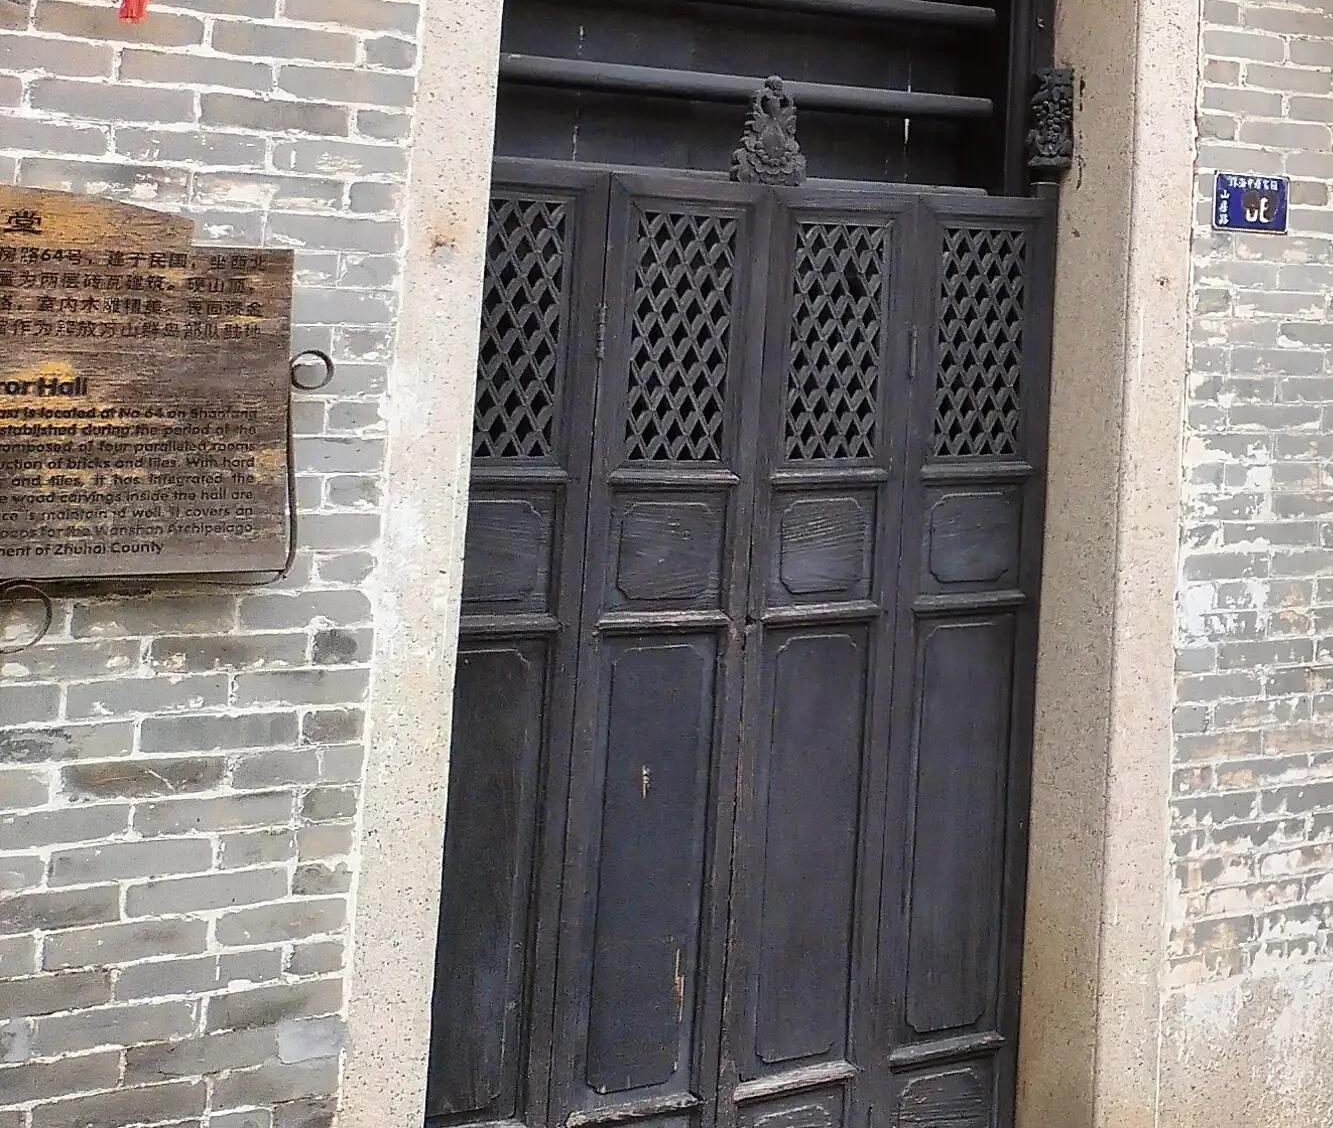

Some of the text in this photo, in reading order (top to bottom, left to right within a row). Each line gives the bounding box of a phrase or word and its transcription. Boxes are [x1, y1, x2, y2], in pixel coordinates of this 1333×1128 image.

[37, 375, 88, 396] Hall
[41, 407, 96, 419] located
[0, 441, 72, 452] omposed
[69, 458, 111, 470] bricks
[115, 456, 143, 468] and
[223, 456, 255, 468] hard
[12, 474, 42, 486] and
[231, 473, 255, 484] the
[35, 542, 52, 555] of
[110, 540, 165, 555] County
